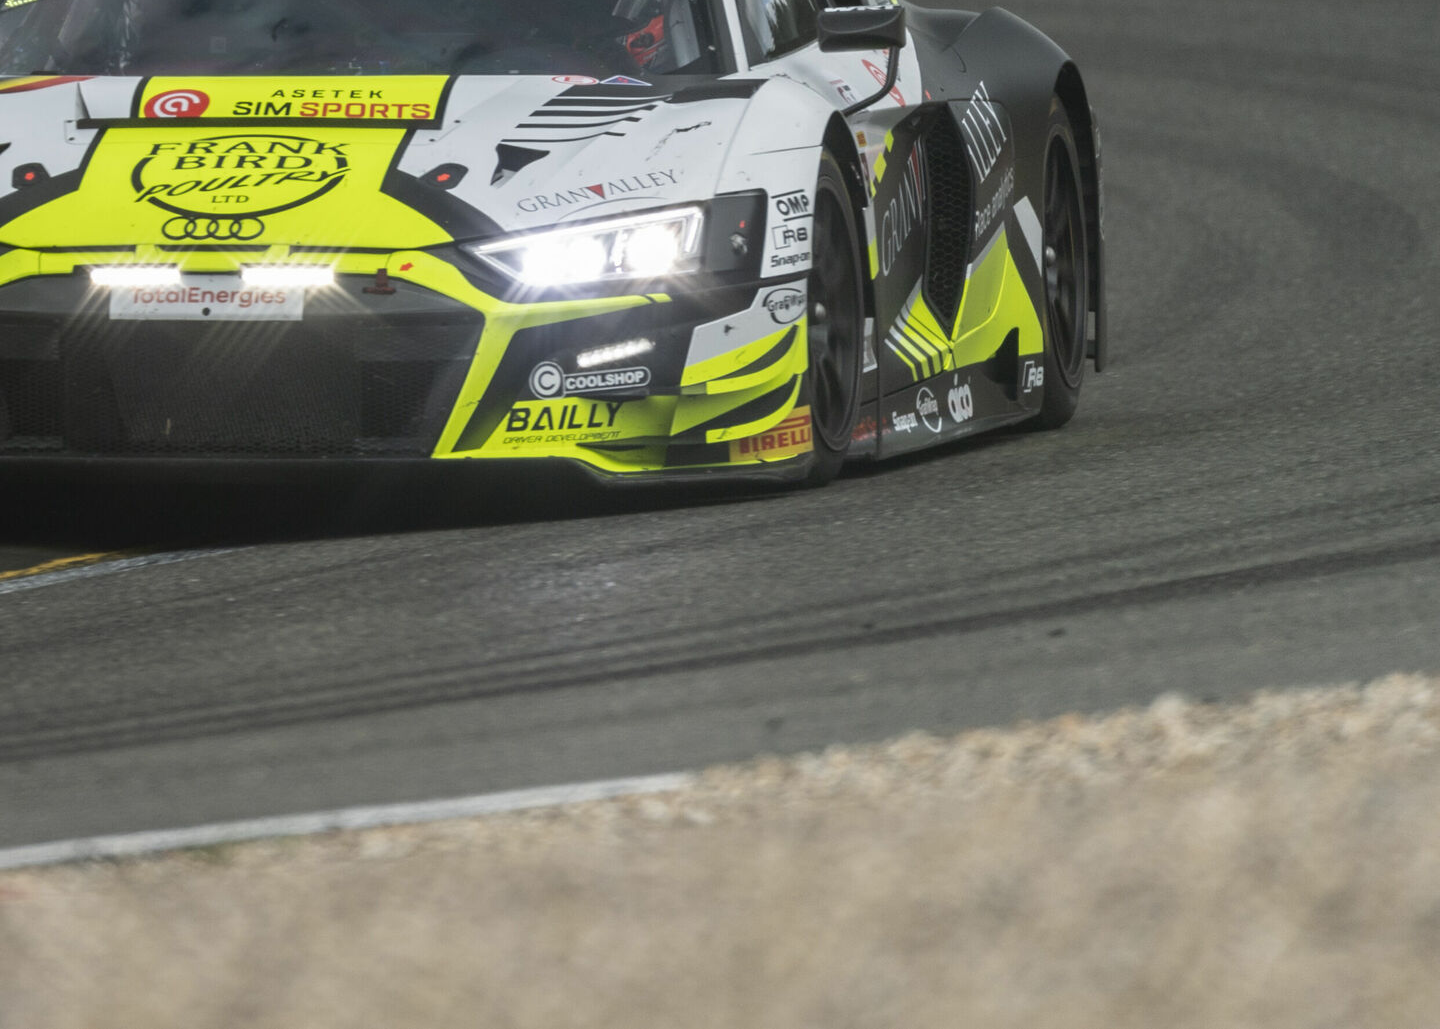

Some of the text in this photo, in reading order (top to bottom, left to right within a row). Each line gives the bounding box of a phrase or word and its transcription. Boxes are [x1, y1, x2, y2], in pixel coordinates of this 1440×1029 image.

[271, 89, 383, 99] ASETEK
[232, 101, 431, 119] SIM SPORTS
[142, 141, 350, 156] FRANK
[173, 155, 313, 171] BIRD
[134, 168, 352, 203] POULTRY
[210, 194, 250, 204] LTD
[776, 194, 810, 216] OMP
[783, 227, 809, 245] R8
[132, 286, 287, 309] TotalEnergies
[565, 370, 646, 391] COOLSHOP
[1027, 367, 1044, 387] R8
[505, 401, 624, 432] BAILLY
[503, 430, 622, 445] DRIVER DEVELOPMENT
[739, 422, 811, 455] PIRELLI
